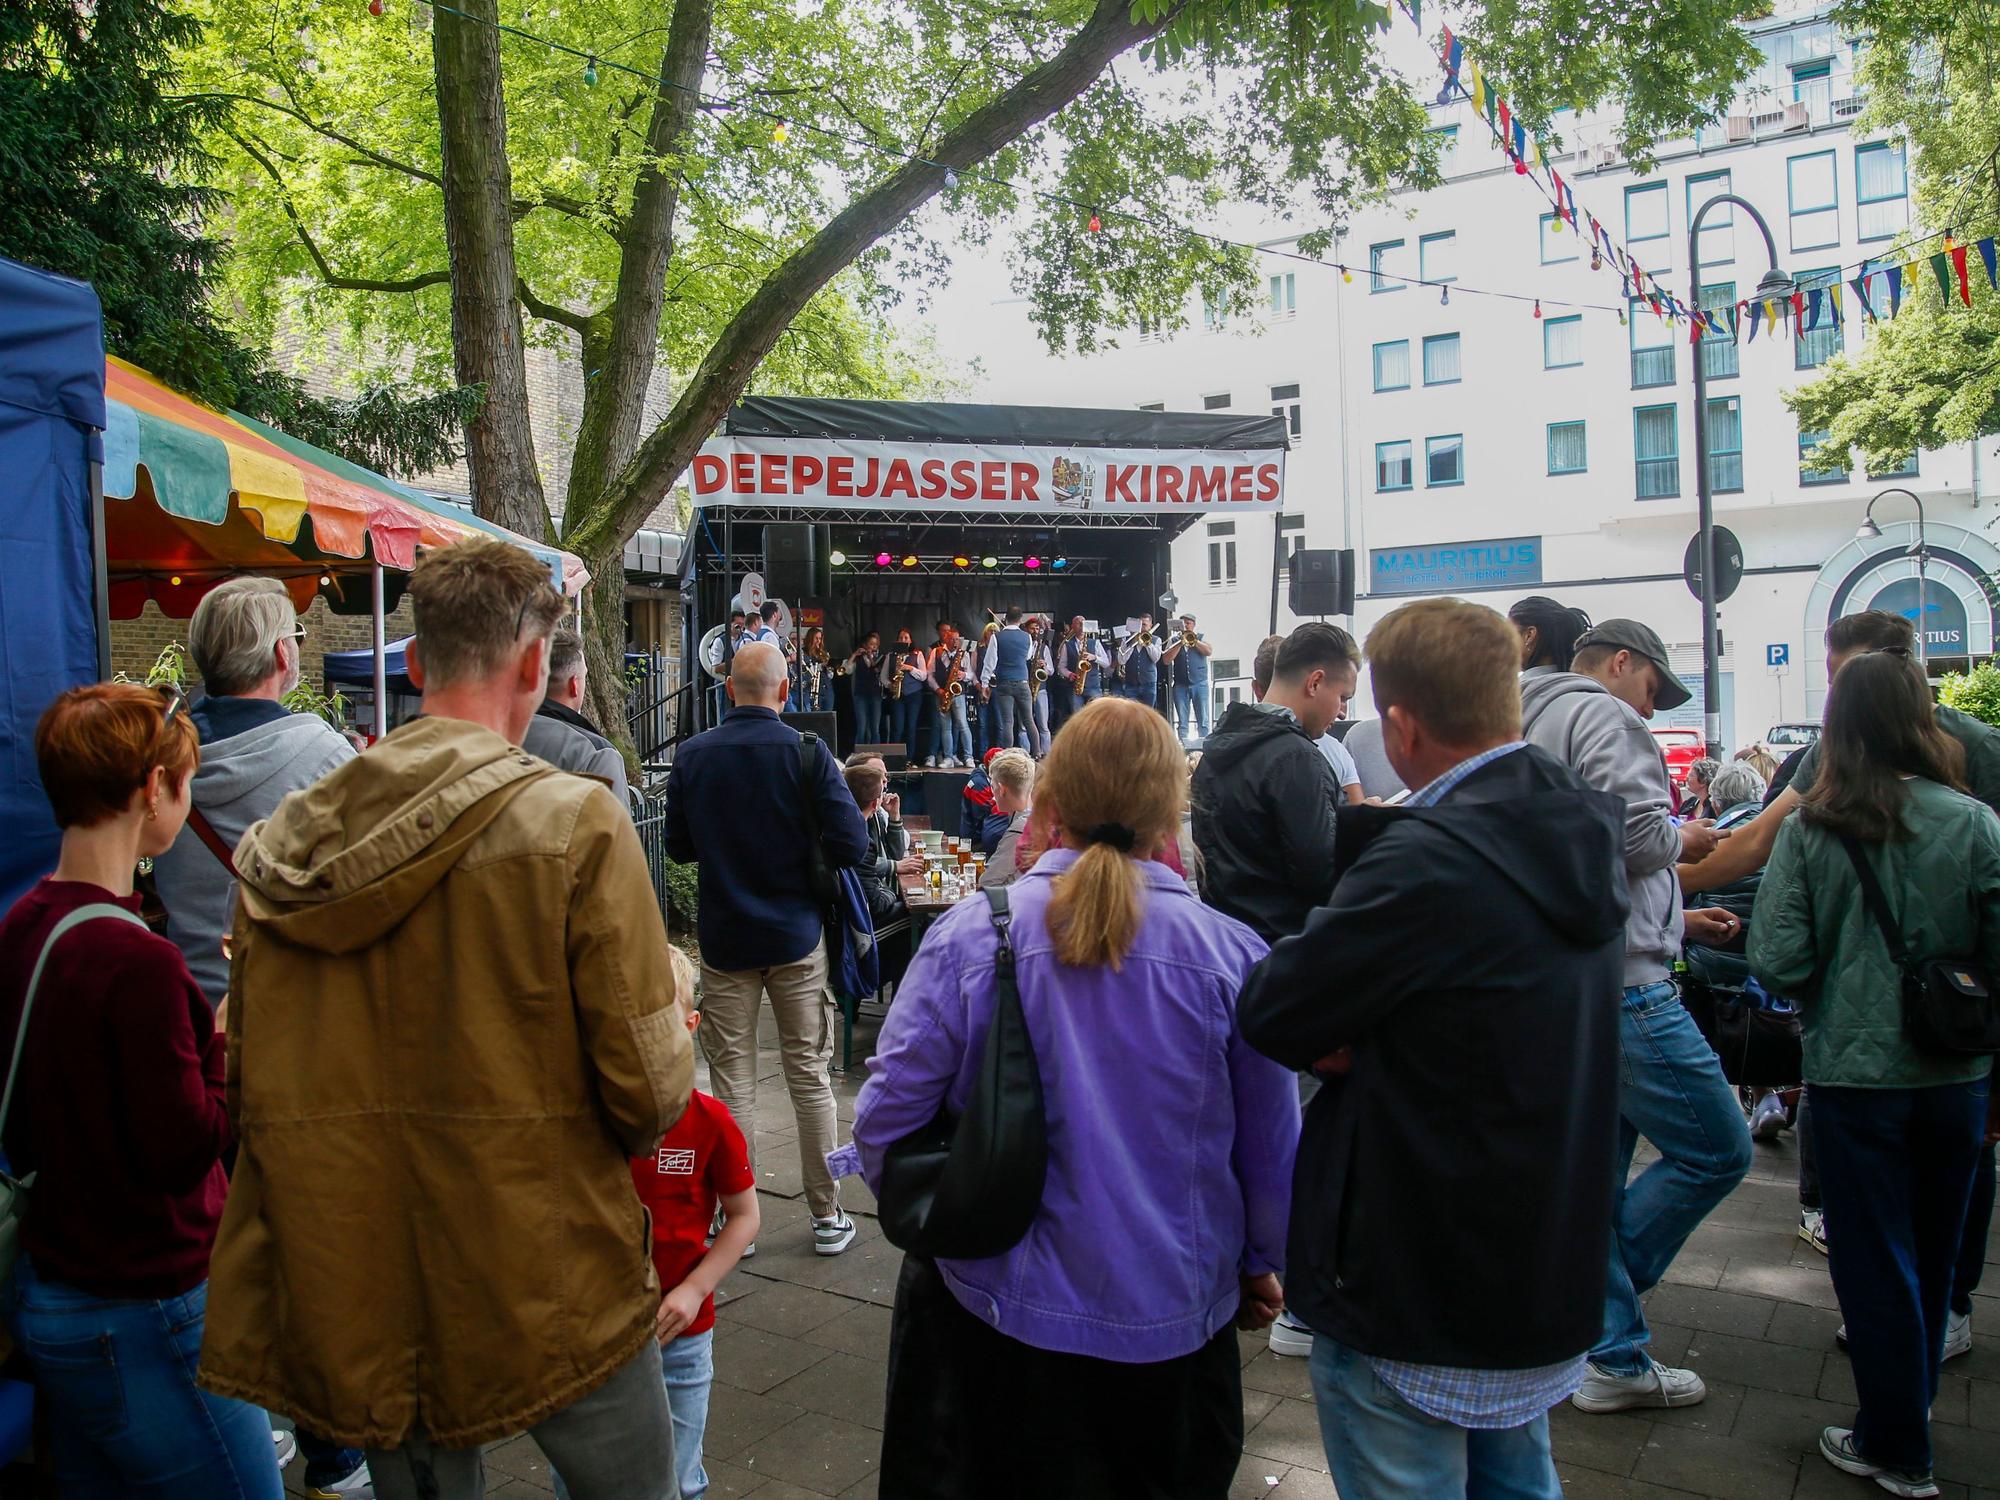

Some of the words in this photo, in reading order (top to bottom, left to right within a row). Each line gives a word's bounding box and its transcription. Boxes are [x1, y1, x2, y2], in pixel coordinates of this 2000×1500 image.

[692, 453, 1041, 502] DEEPEJASSER
[1104, 463, 1280, 503] KIRMES
[1376, 543, 1537, 574] MAURITIUS
[1403, 572, 1441, 585] HOTEL
[1460, 568, 1508, 581] THERME
[1912, 630, 1960, 644] RTIUS
[1771, 646, 1784, 663] P
